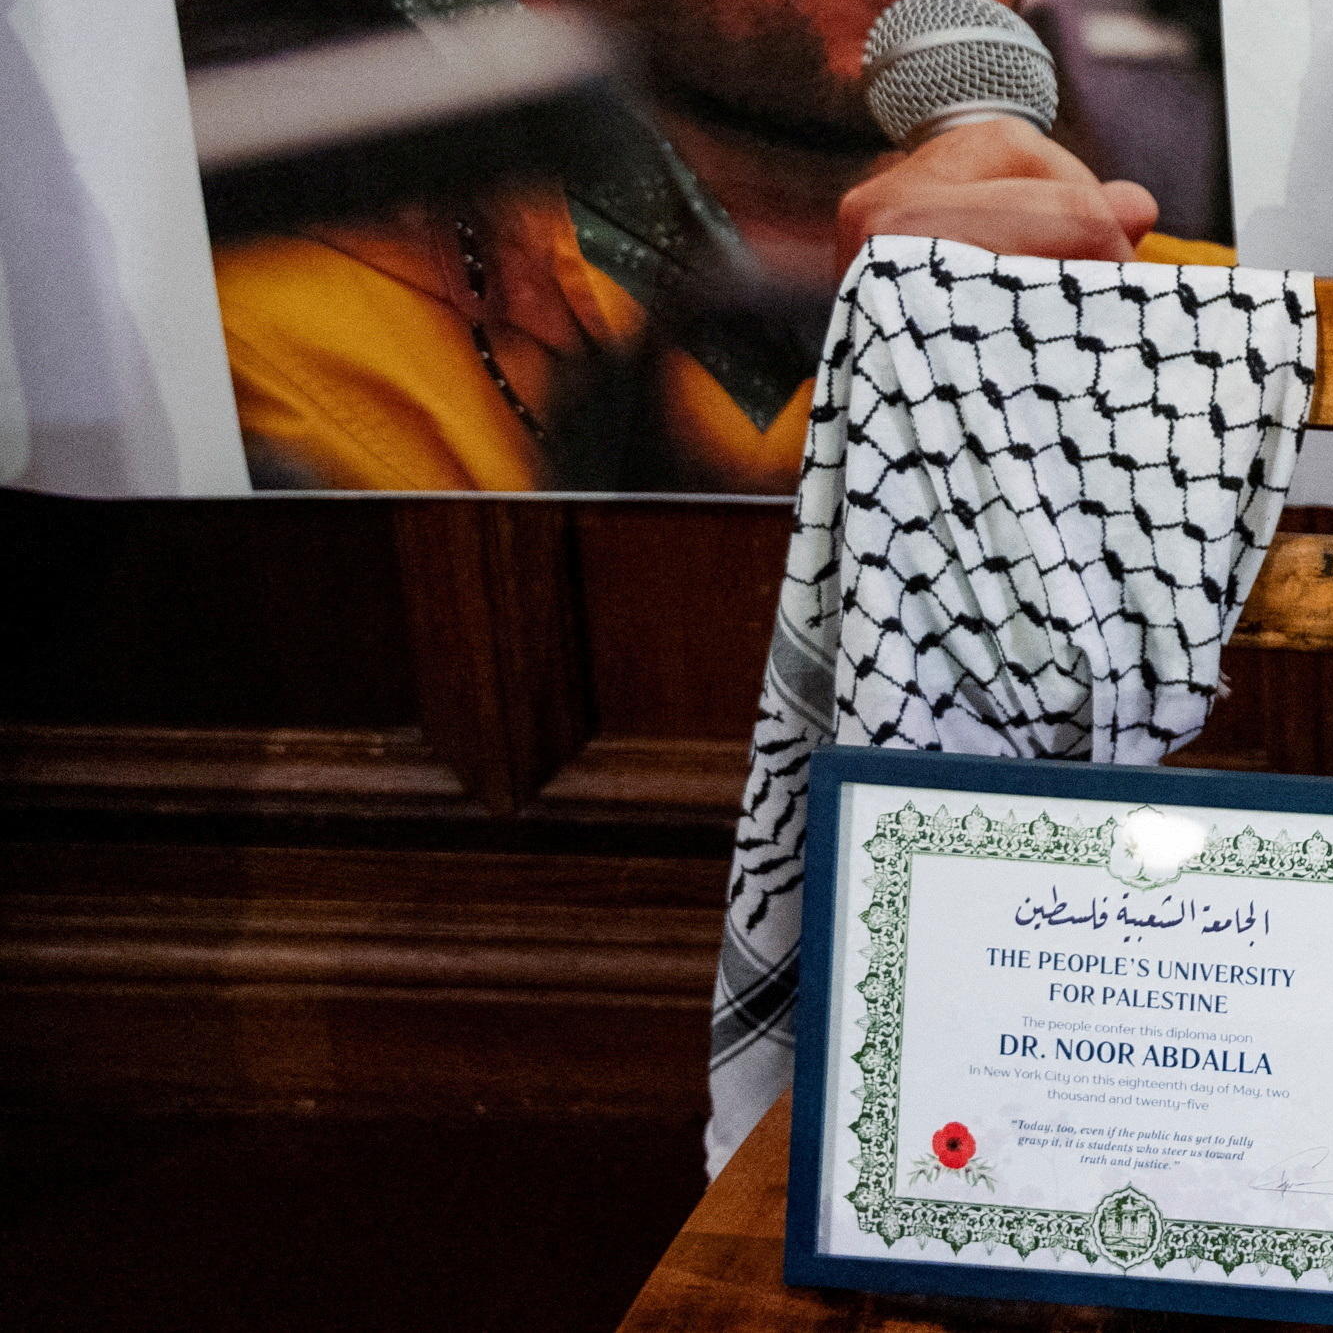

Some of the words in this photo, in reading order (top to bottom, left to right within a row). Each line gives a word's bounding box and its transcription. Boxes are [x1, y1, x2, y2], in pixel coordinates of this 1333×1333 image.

[1014, 884, 1108, 930] فلسطين
[1116, 891, 1195, 943] الشعبية
[1200, 899, 1269, 947] الجامعة
[985, 947, 1031, 968] THE
[1157, 959, 1295, 987] UNIVERSITY
[1048, 982, 1095, 1005] FOR
[1101, 986, 1228, 1014] PALESTINE
[998, 1033, 1045, 1060] DR.
[1054, 1037, 1135, 1067] NOOR
[1141, 1044, 1272, 1075] ABDALLA
[968, 1064, 980, 1075] In
[983, 1065, 1010, 1077] New
[1013, 1067, 1041, 1080] York
[1043, 1069, 1070, 1085] City
[1072, 1074, 1089, 1084] on
[1092, 1073, 1115, 1086] this
[1117, 1075, 1187, 1091] eighteenth
[1189, 1081, 1214, 1095] day
[1216, 1082, 1230, 1093] of
[1232, 1084, 1262, 1099] May,
[1265, 1087, 1290, 1098] two
